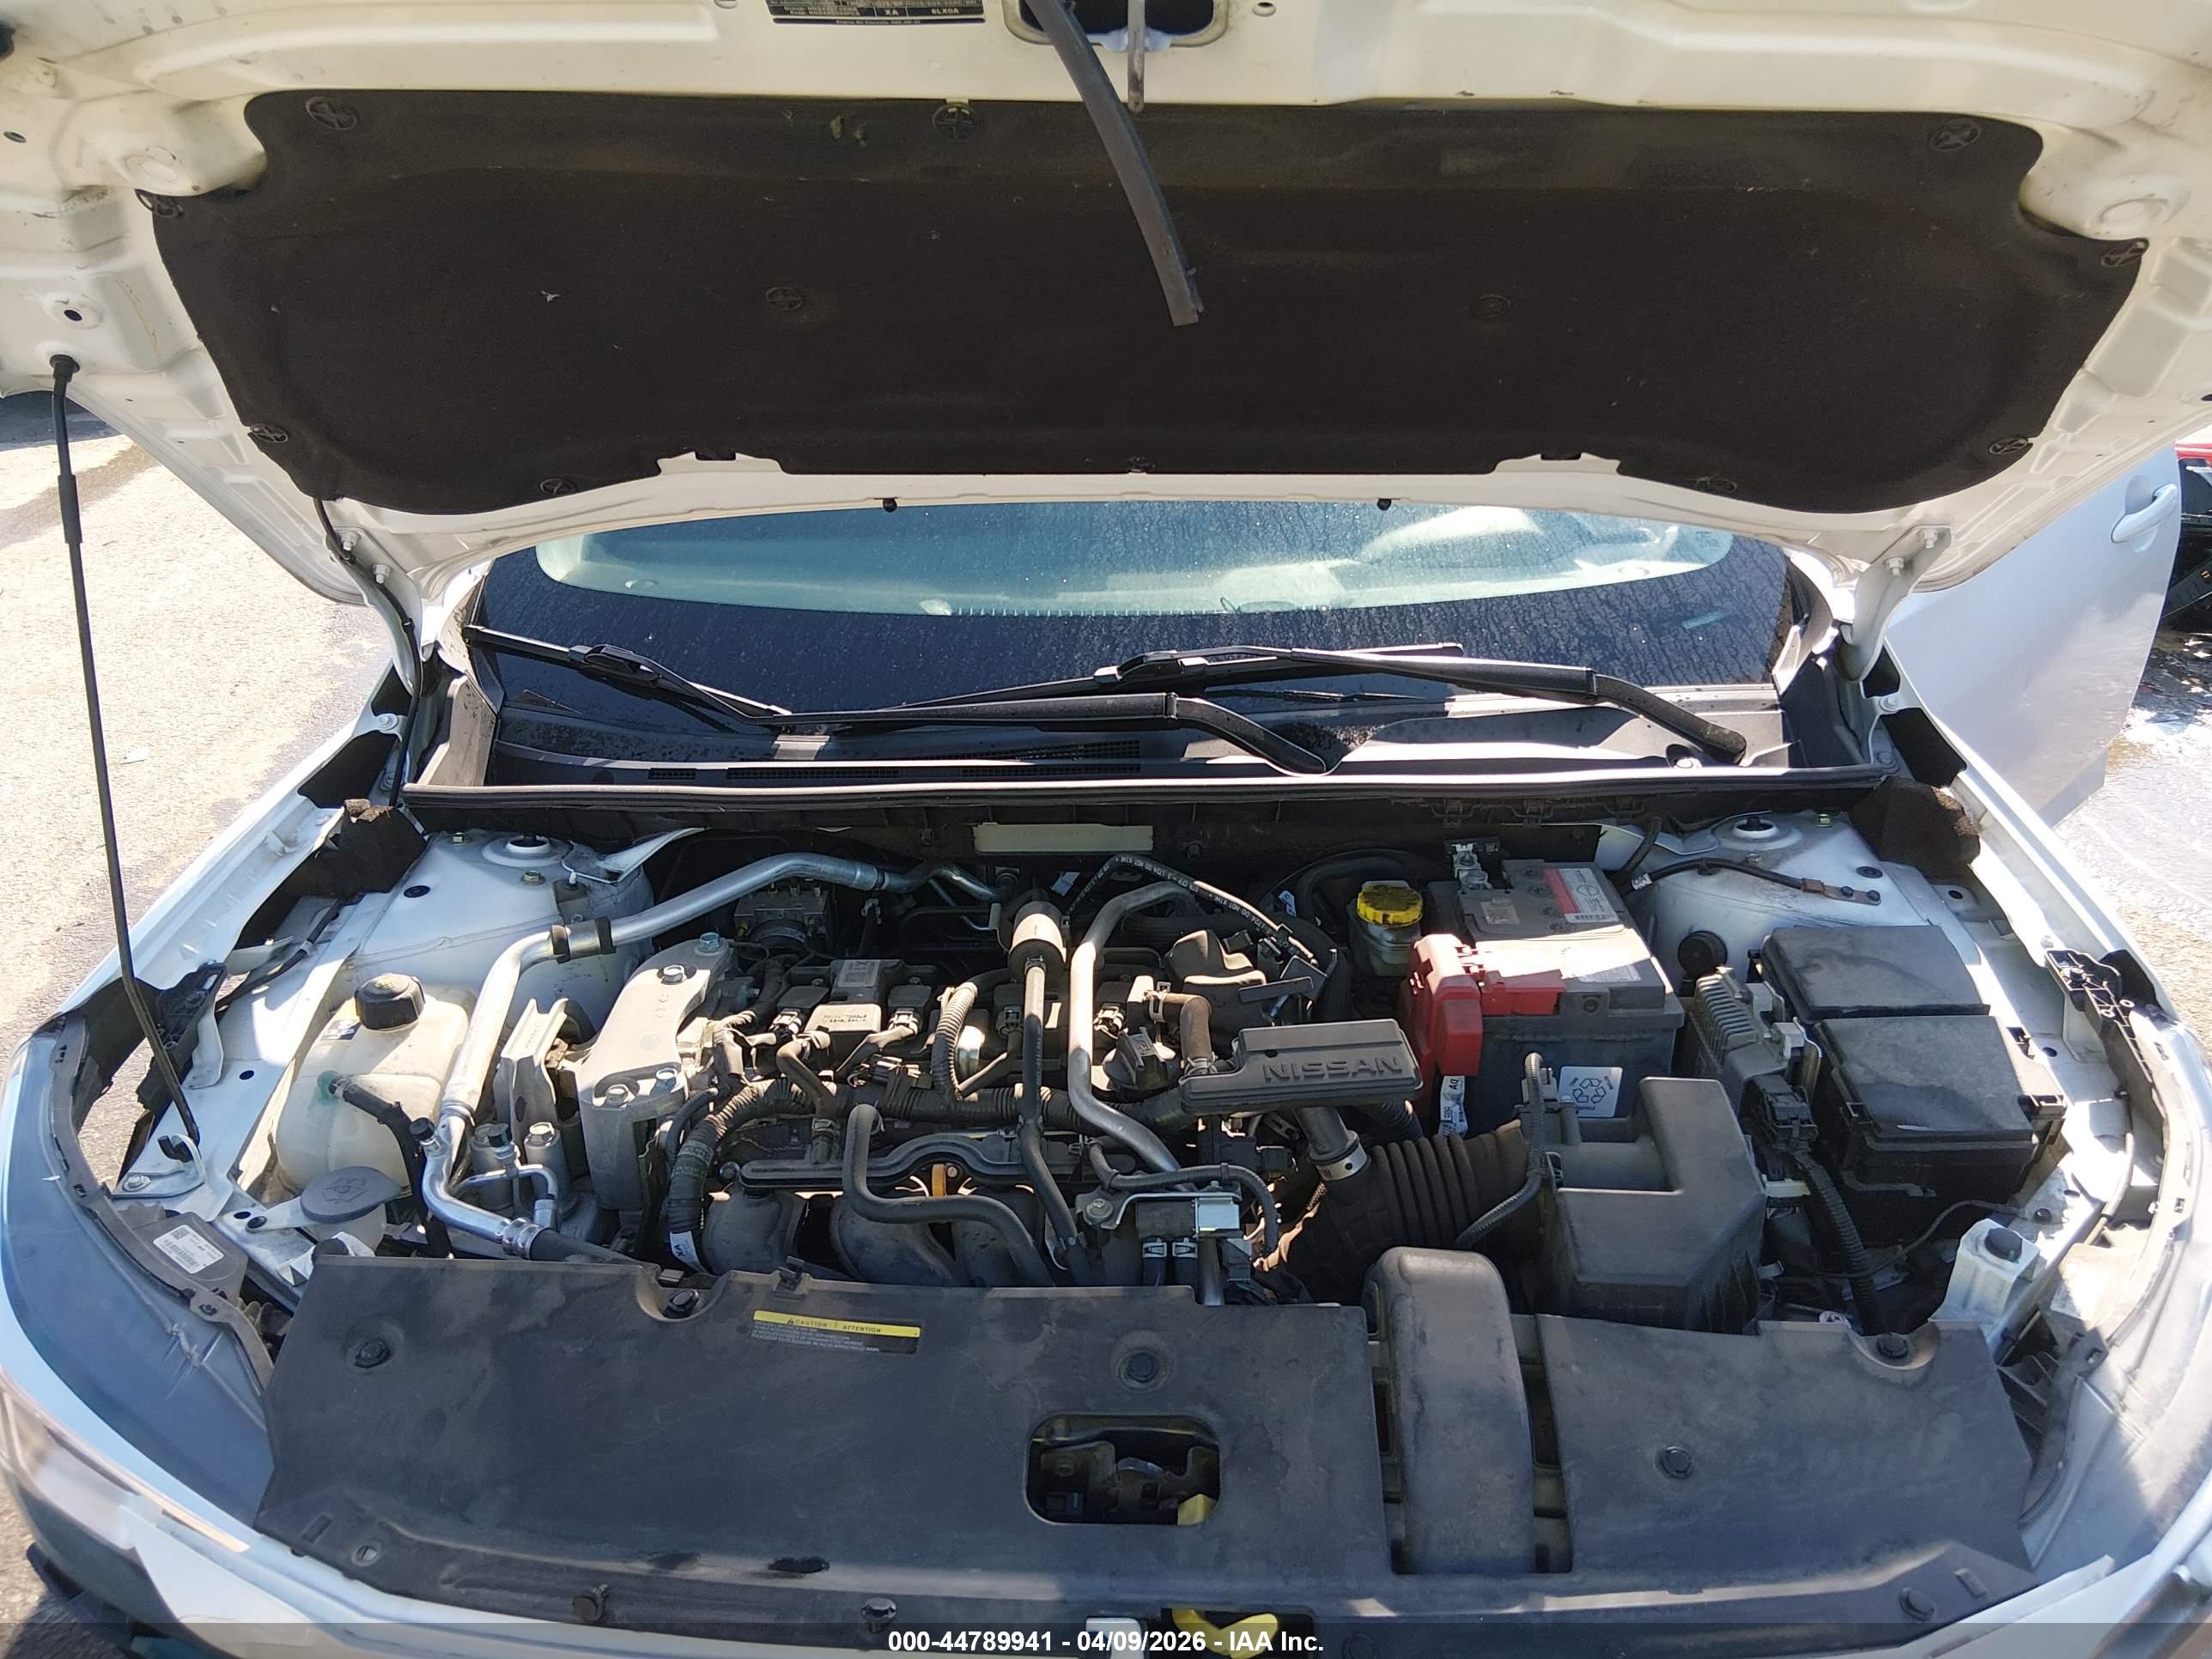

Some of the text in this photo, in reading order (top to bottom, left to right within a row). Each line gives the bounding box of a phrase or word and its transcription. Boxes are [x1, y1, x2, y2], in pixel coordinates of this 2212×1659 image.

[1261, 1056, 1402, 1084] NISSAN
[795, 1319, 882, 1334] CAUTION ATTENTION
